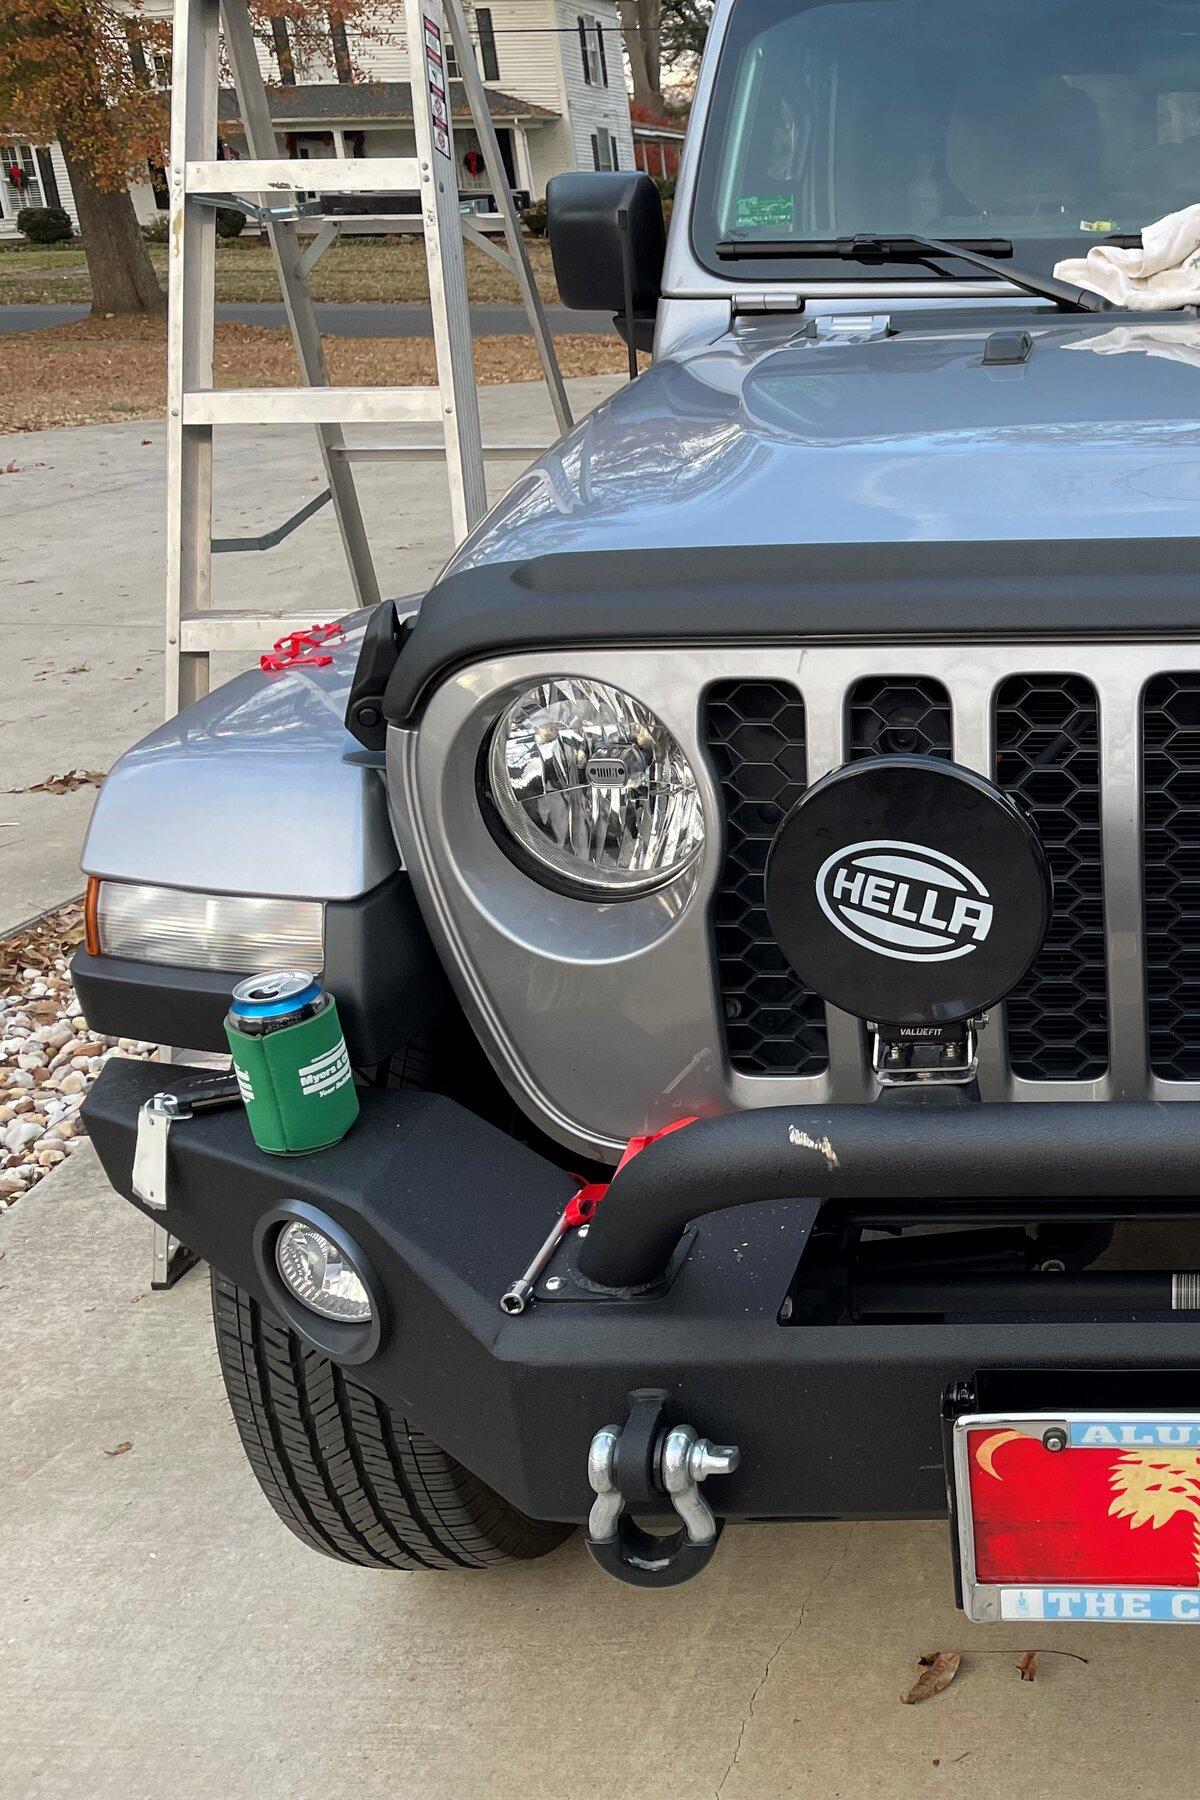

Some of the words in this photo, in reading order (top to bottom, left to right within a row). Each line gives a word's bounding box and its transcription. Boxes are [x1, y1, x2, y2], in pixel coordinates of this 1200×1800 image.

[833, 868, 994, 942] HELLA
[900, 1028, 943, 1036] VALUEFIT
[300, 1065, 337, 1087] Myers
[1047, 1592, 1152, 1619] THE
